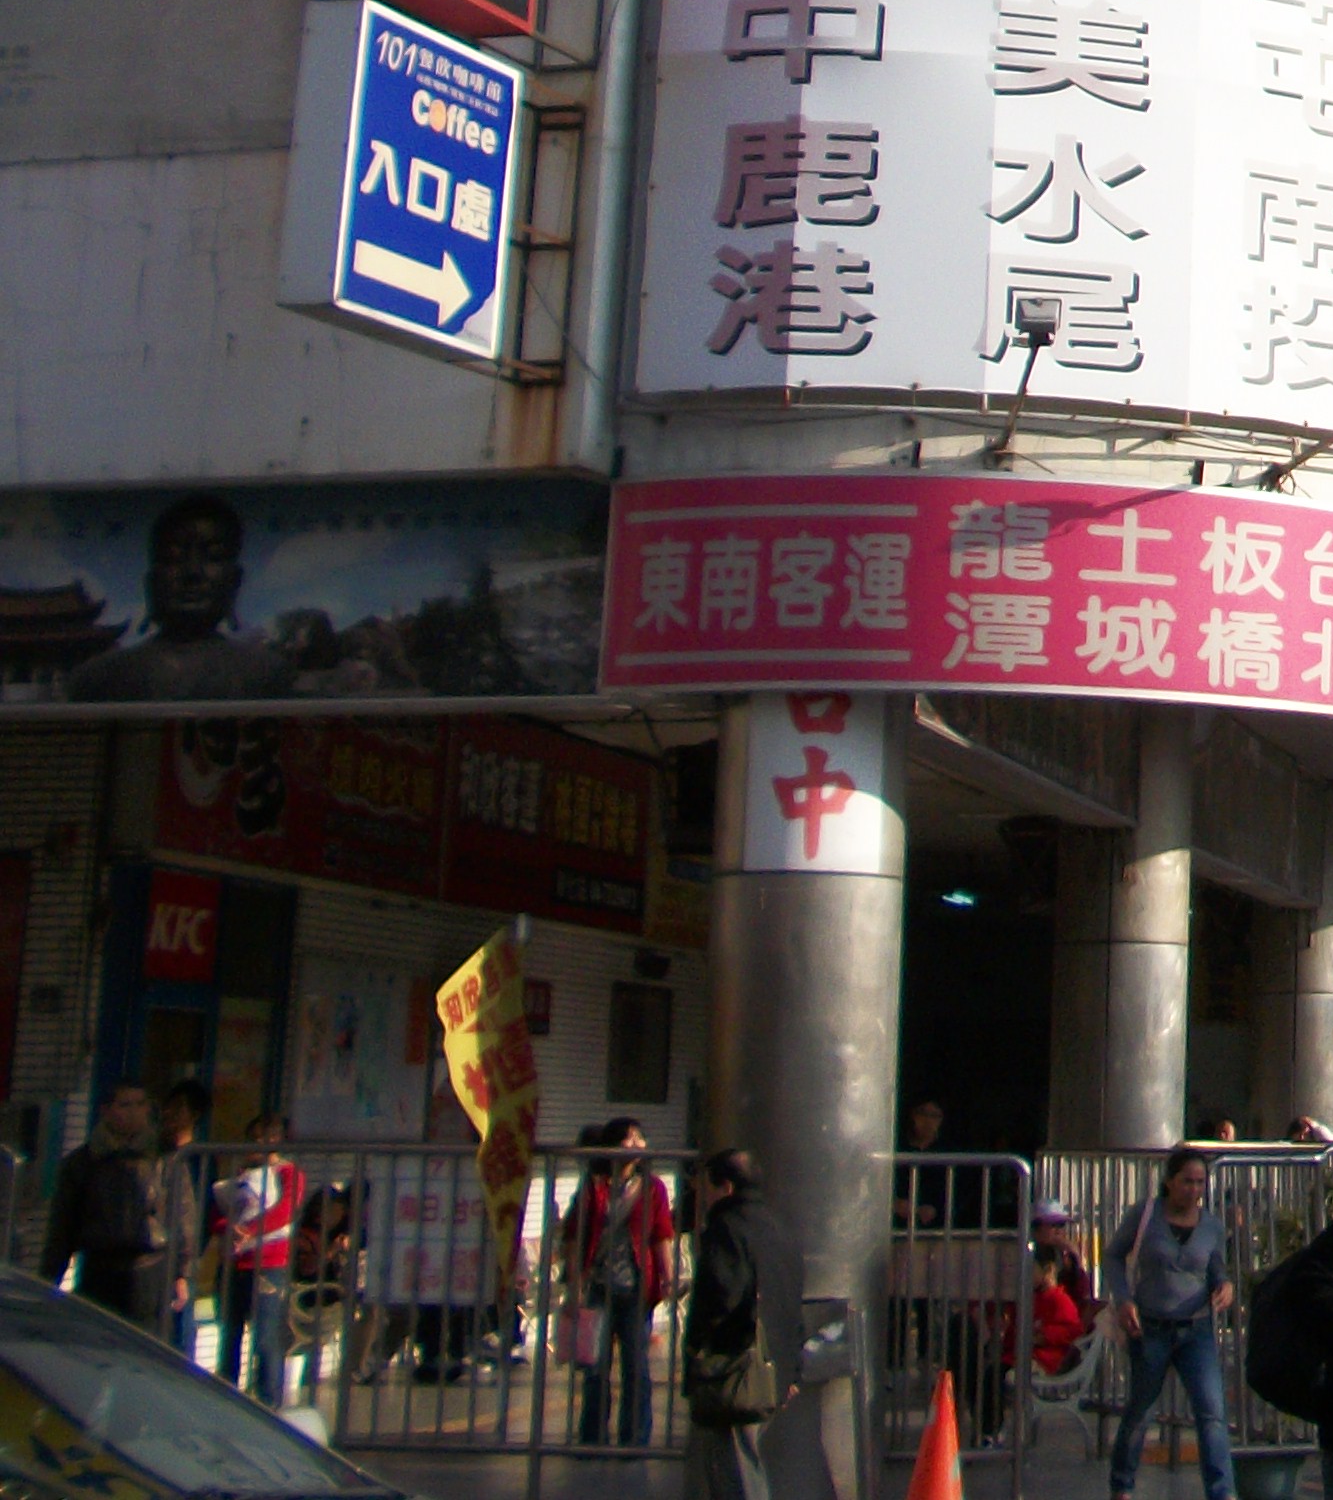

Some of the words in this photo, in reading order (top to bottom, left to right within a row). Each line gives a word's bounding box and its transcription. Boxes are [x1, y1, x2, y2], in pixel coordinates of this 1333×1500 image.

[359, 139, 495, 241] 入口處
[411, 88, 500, 156] Coffee
[707, 114, 880, 359] 鹿港
[979, 131, 1152, 373] 水尾
[633, 527, 911, 634] 東南客運
[942, 499, 1053, 674] 龍潭
[1075, 507, 1178, 679] 土城
[1197, 514, 1286, 693] 板橋
[147, 902, 212, 956] KFC
